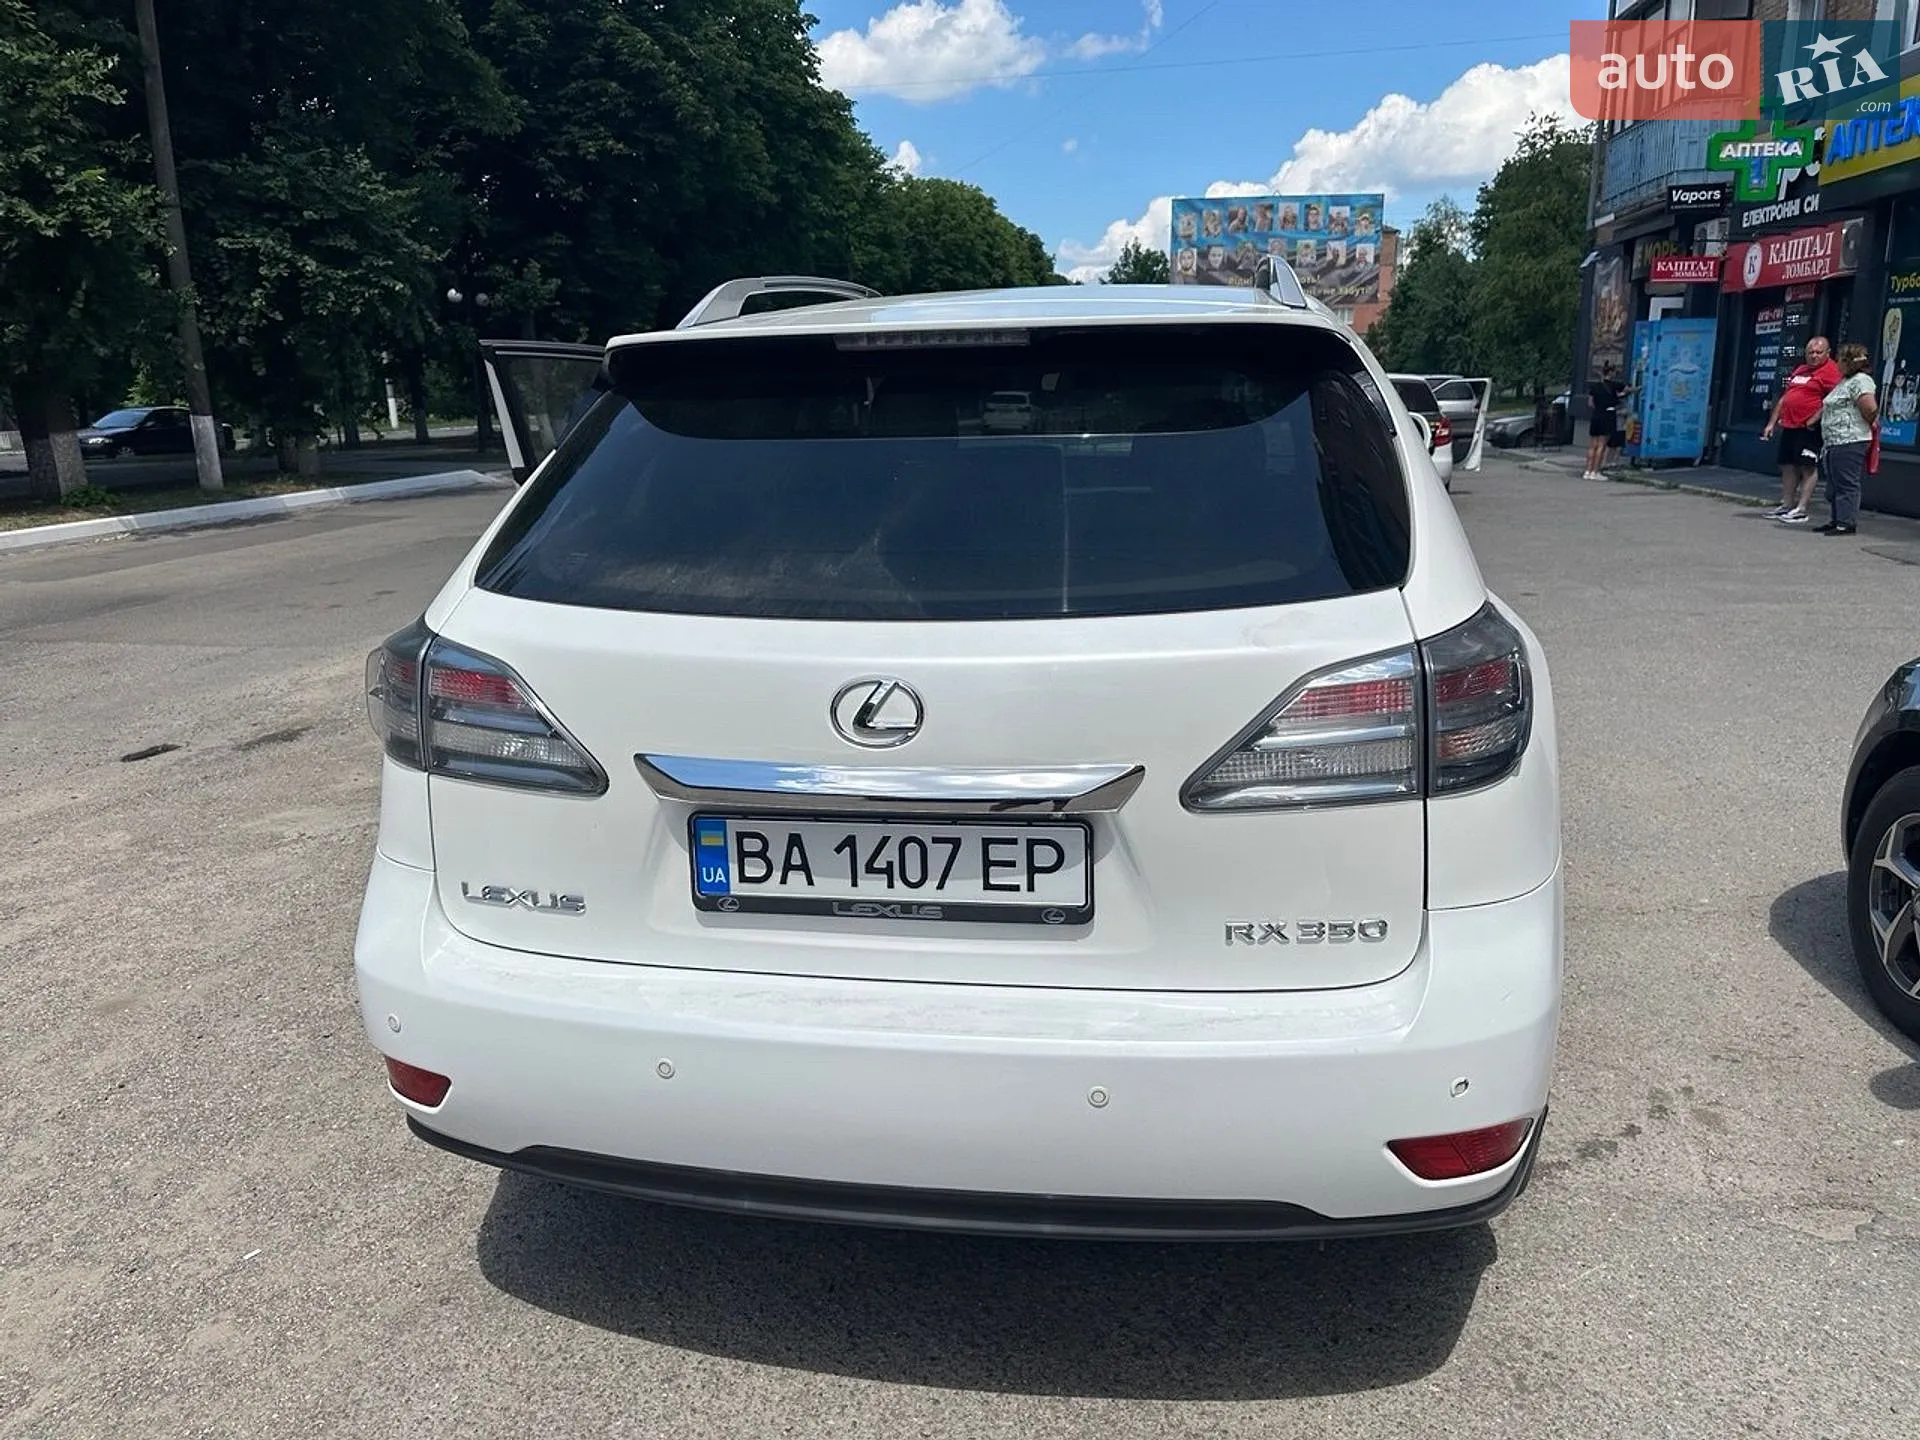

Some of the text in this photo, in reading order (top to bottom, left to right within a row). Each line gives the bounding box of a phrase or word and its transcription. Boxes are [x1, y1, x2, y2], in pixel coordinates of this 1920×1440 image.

[1719, 141, 1803, 158] АПТЕКА
[1672, 189, 1722, 203] Vapors
[1742, 200, 1800, 229] ЕЛЕКТРОННІ
[1768, 231, 1836, 266] КАПІТАЛ
[1656, 260, 1715, 272] КАПІТАЛ
[1782, 257, 1831, 280] ЛОМБАРД
[736, 830, 1066, 893] BA 1407 EP
[702, 867, 728, 884] UA
[461, 880, 587, 917] LEXUS
[832, 901, 944, 919] LEXUS
[1225, 919, 1388, 945] RX 350
